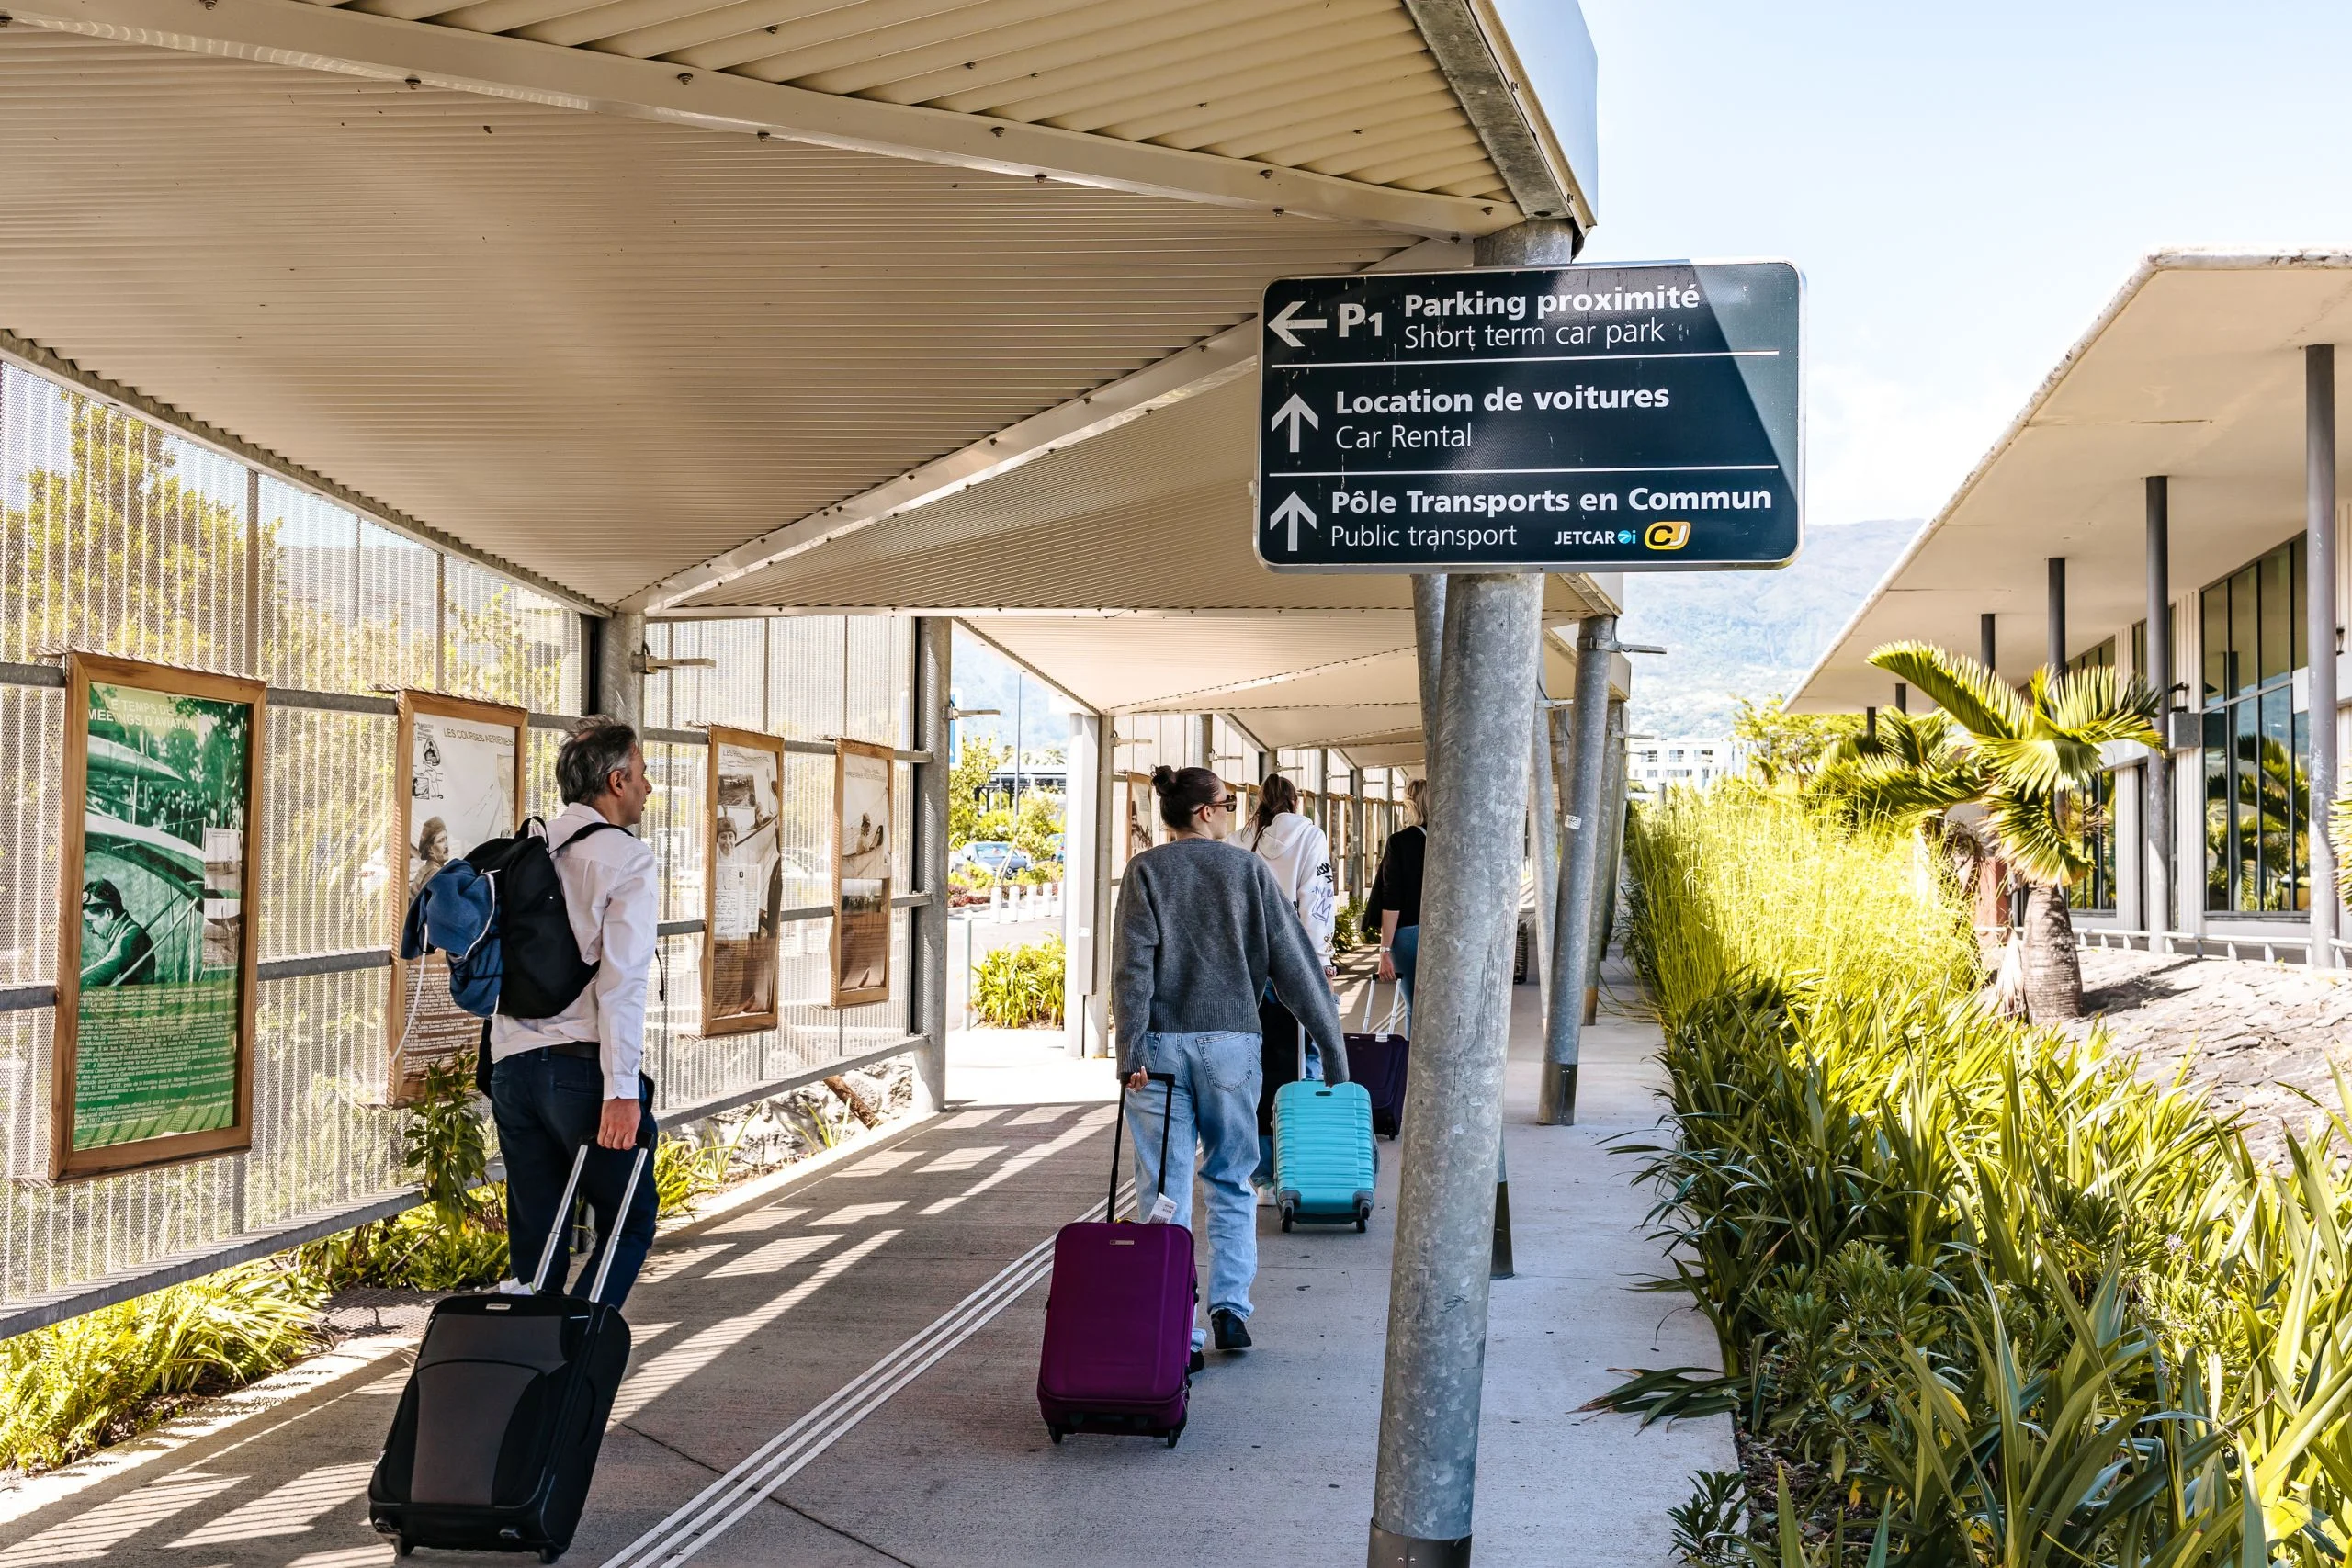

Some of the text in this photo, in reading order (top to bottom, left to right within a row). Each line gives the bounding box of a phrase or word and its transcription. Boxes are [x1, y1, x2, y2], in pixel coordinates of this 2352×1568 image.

[1405, 284, 1699, 320] Parking proximité
[1339, 303, 1382, 338] P1
[1405, 317, 1665, 349] Short term car park
[1337, 384, 1669, 414] Location de voitures
[1336, 423, 1471, 449] Car Rental
[1332, 487, 1771, 518] Pôle Transports en Commun
[1331, 524, 1517, 551] Public transport
[121, 700, 156, 714] TEMPS
